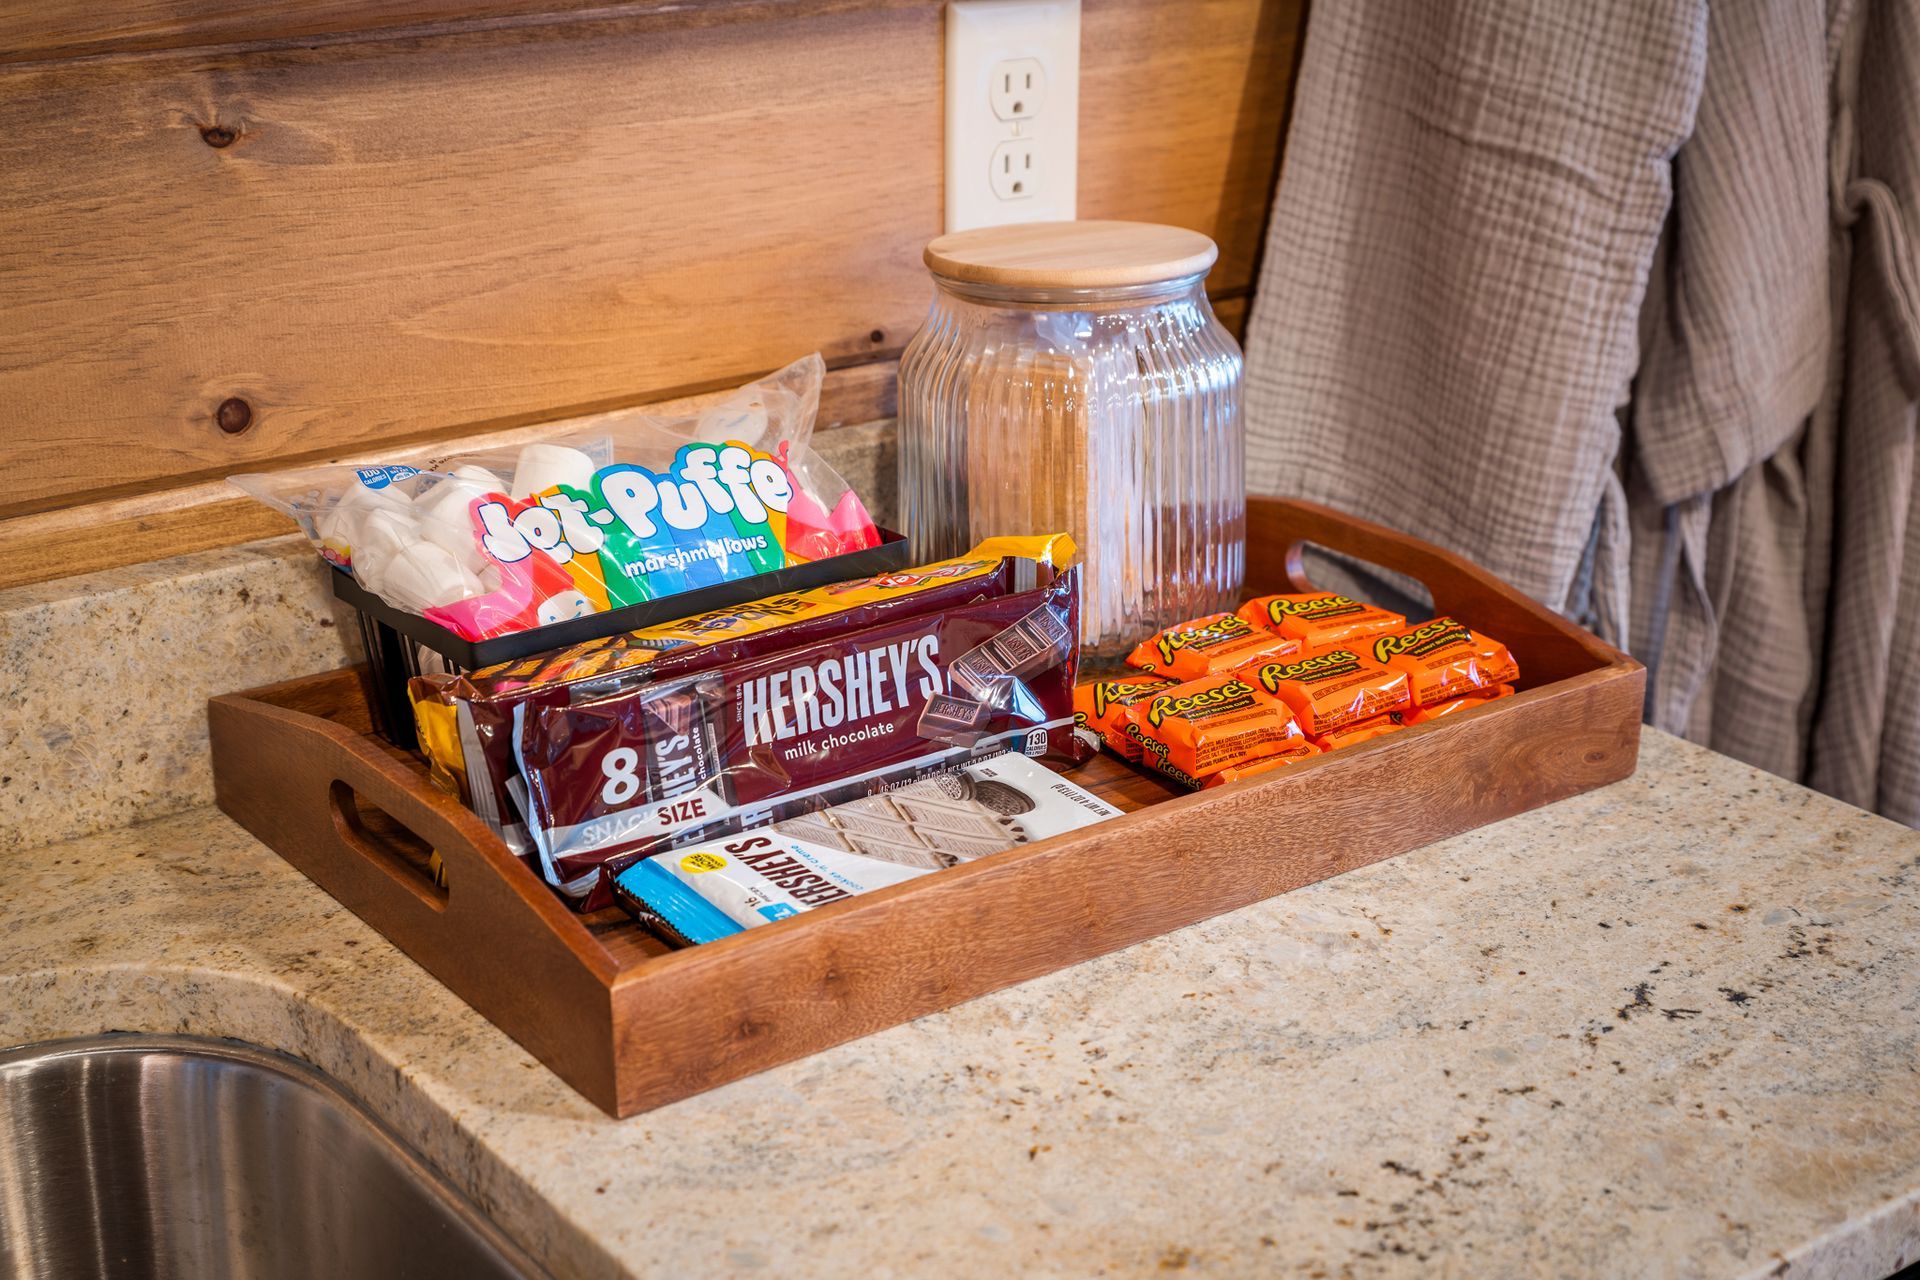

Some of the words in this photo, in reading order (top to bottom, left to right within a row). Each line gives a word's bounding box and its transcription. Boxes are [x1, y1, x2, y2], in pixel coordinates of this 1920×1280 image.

[363, 474, 387, 485] CALORIES
[478, 446, 793, 563] Jet-Puffe
[624, 535, 767, 577] marshmallows
[1157, 614, 1249, 666] Reese's
[1414, 641, 1436, 655] PEANUT
[1435, 634, 1457, 647] BUTTER
[743, 634, 944, 748] HERSHEY'S
[1258, 650, 1360, 695] Reese's
[1301, 671, 1323, 681] PEANUT
[1322, 667, 1342, 677] BUTTER
[1342, 663, 1357, 671] CUPS
[1147, 680, 1256, 729] Reese's
[1210, 704, 1234, 713] BUTTER
[1233, 699, 1250, 707] CUPS
[692, 727, 706, 780] chocolate
[784, 740, 817, 761] milk
[821, 721, 894, 750] chocolate
[1029, 731, 1046, 746] 130
[1125, 722, 1170, 760] Reese's
[601, 747, 639, 805] 8
[657, 798, 706, 826] SIZE
[1083, 802, 1100, 810] WT
[1093, 807, 1112, 816] NET
[724, 836, 856, 908] ERSHEY'S
[791, 845, 819, 864] creme
[744, 897, 761, 907] 16
